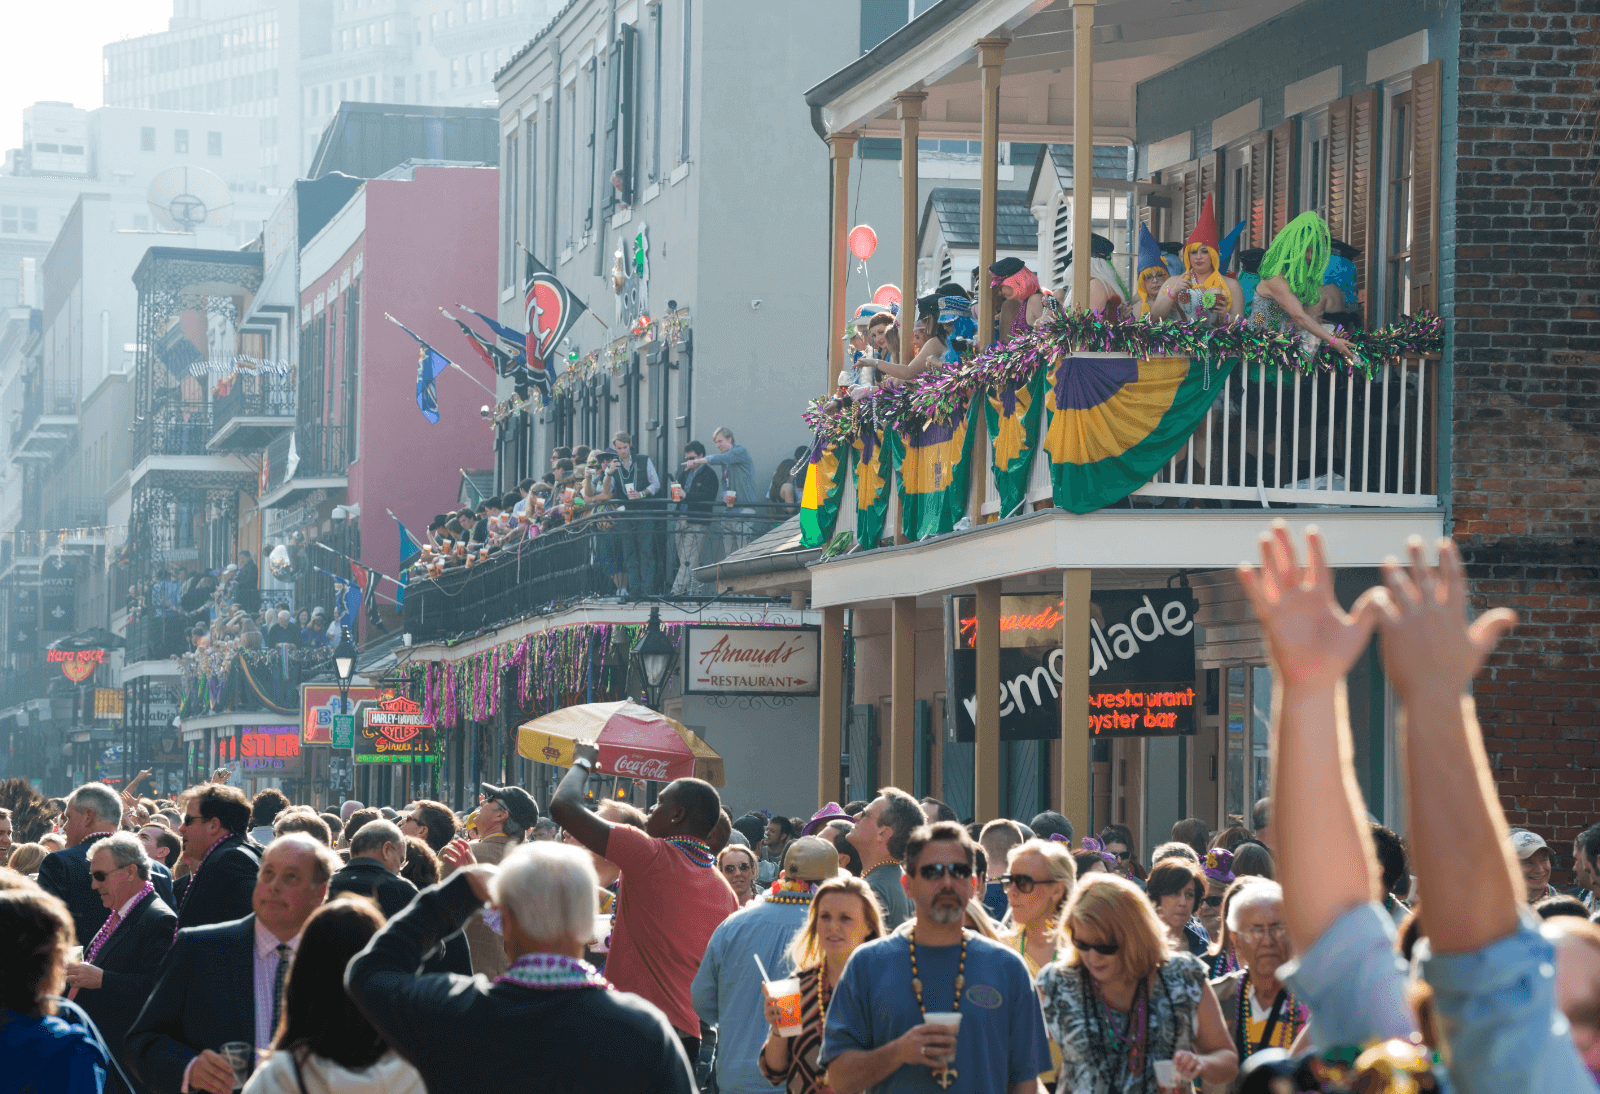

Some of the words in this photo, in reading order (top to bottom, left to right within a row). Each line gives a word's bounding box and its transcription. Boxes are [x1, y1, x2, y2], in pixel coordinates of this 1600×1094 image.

[43, 578, 74, 586] HYATT
[699, 634, 804, 674] Arnaud's
[710, 675, 793, 687] RESTAURANT
[1097, 687, 1195, 708] restaurant
[1143, 707, 1178, 728] bar
[384, 726, 415, 740] CYCLES
[614, 755, 670, 779] Coca-Cola
